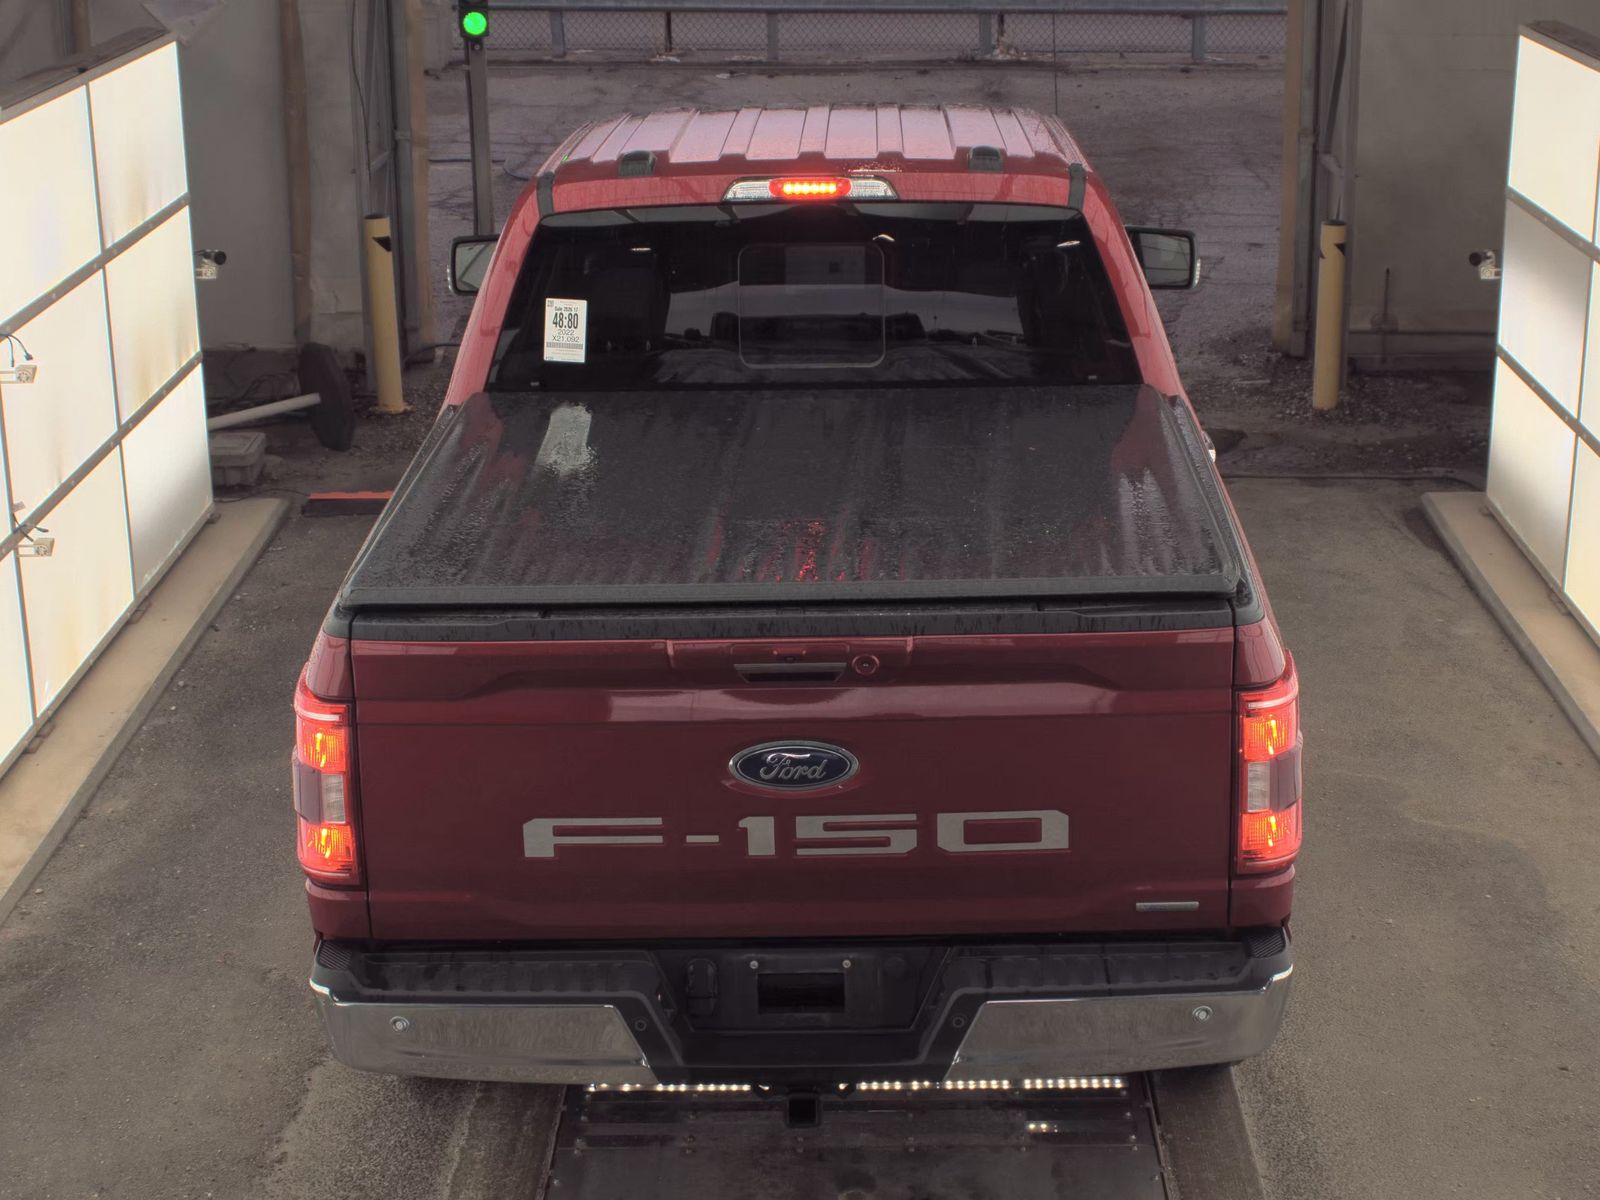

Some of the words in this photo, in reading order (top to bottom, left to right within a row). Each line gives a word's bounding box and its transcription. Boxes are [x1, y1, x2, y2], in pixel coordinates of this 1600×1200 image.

[552, 312, 579, 329] 48:80
[760, 752, 828, 780] Ford
[522, 809, 1070, 858] F-150
